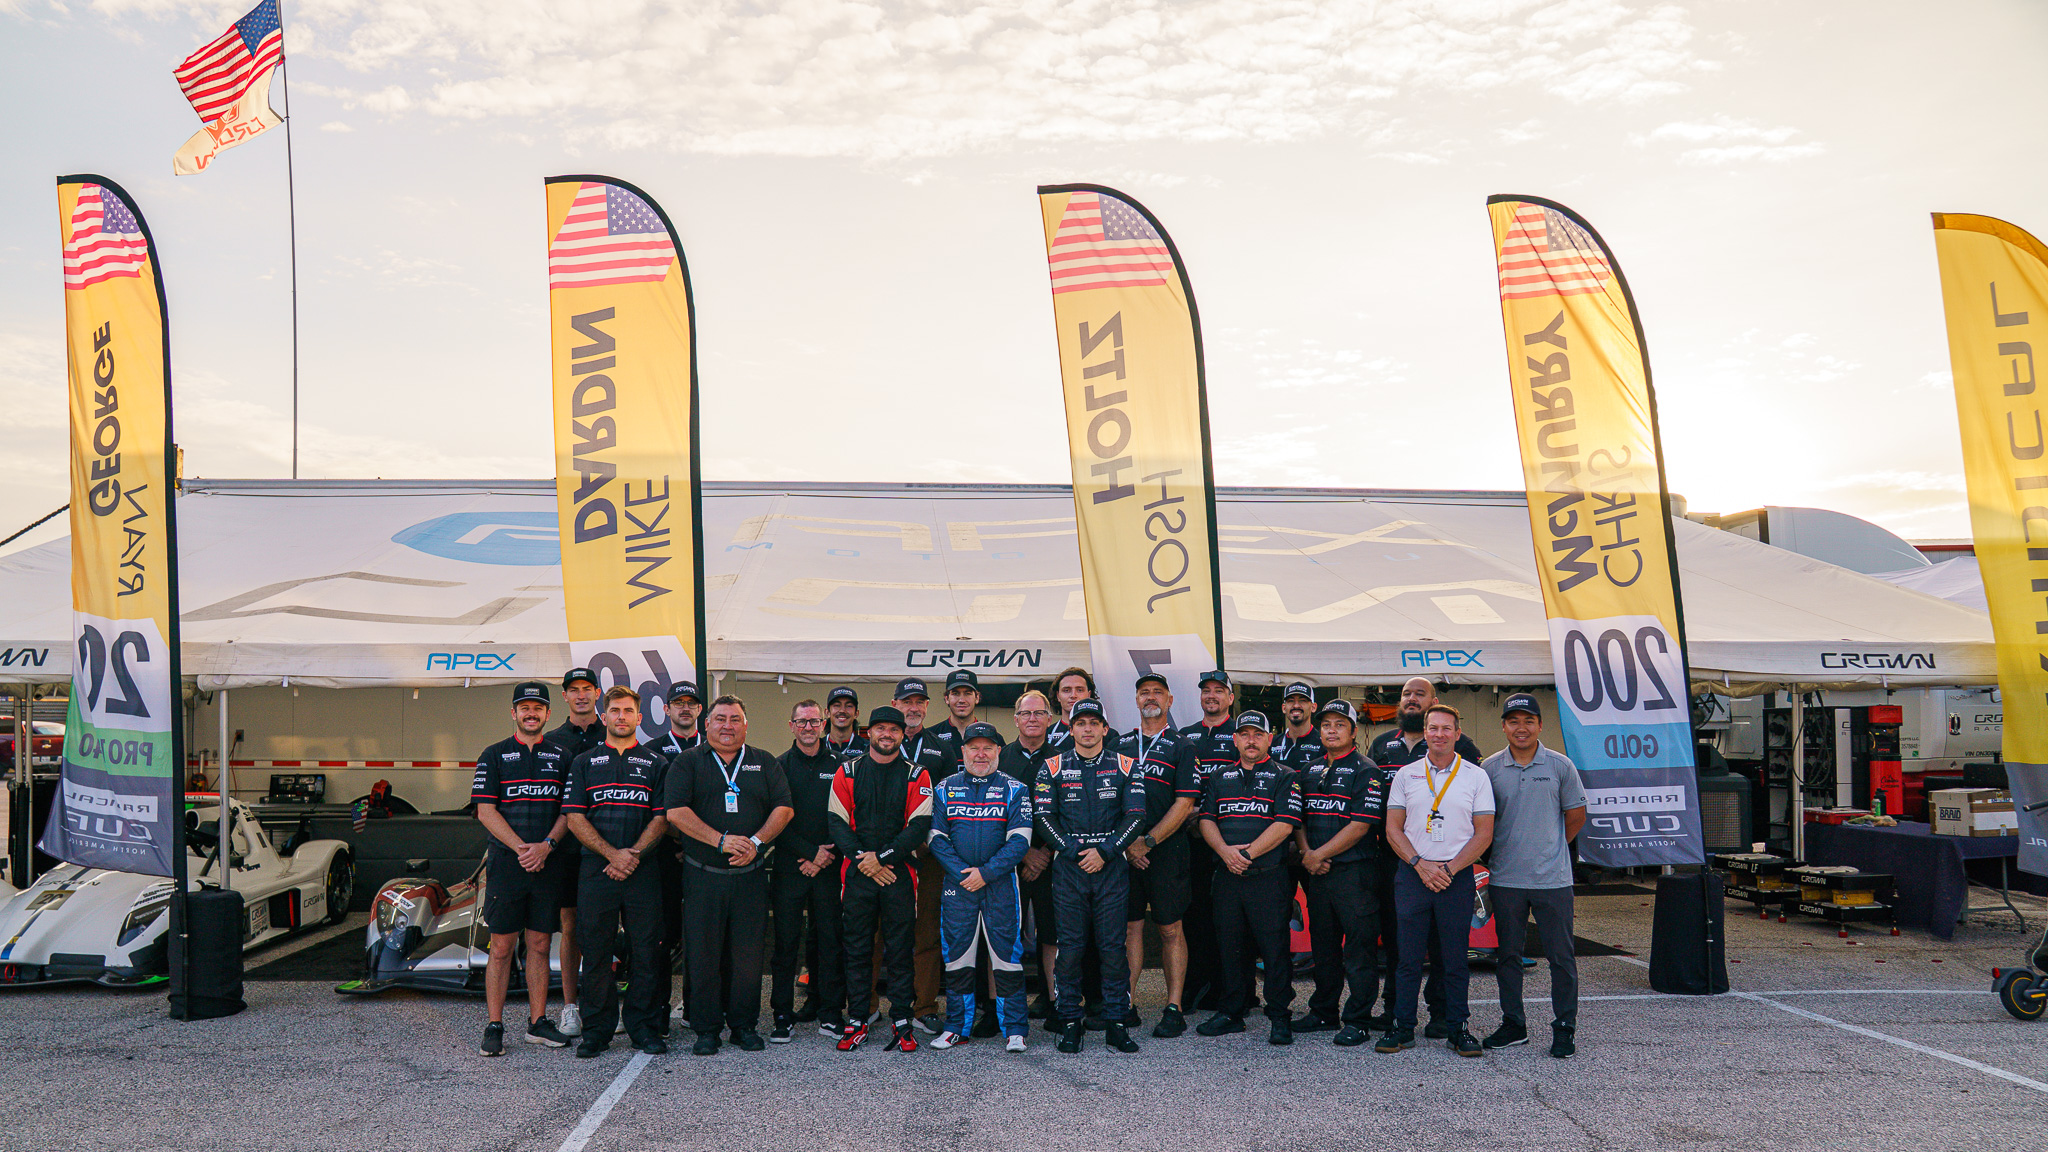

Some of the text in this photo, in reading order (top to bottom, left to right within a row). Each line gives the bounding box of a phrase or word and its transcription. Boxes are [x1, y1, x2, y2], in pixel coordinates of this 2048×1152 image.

[426, 652, 517, 671] APEX
[906, 648, 1042, 668] CROWN
[1401, 649, 1486, 668] APEX
[1820, 652, 1936, 669] CROWN
[506, 784, 561, 797] CROWN
[593, 788, 650, 802] CROWN
[946, 805, 1005, 817] CROWN
[1218, 801, 1269, 814] CROWN
[1939, 809, 1962, 819] BRAID
[1041, 816, 1066, 847] RADICAL
[1800, 875, 1827, 886] CROWN
[1799, 904, 1824, 916] CROWN
